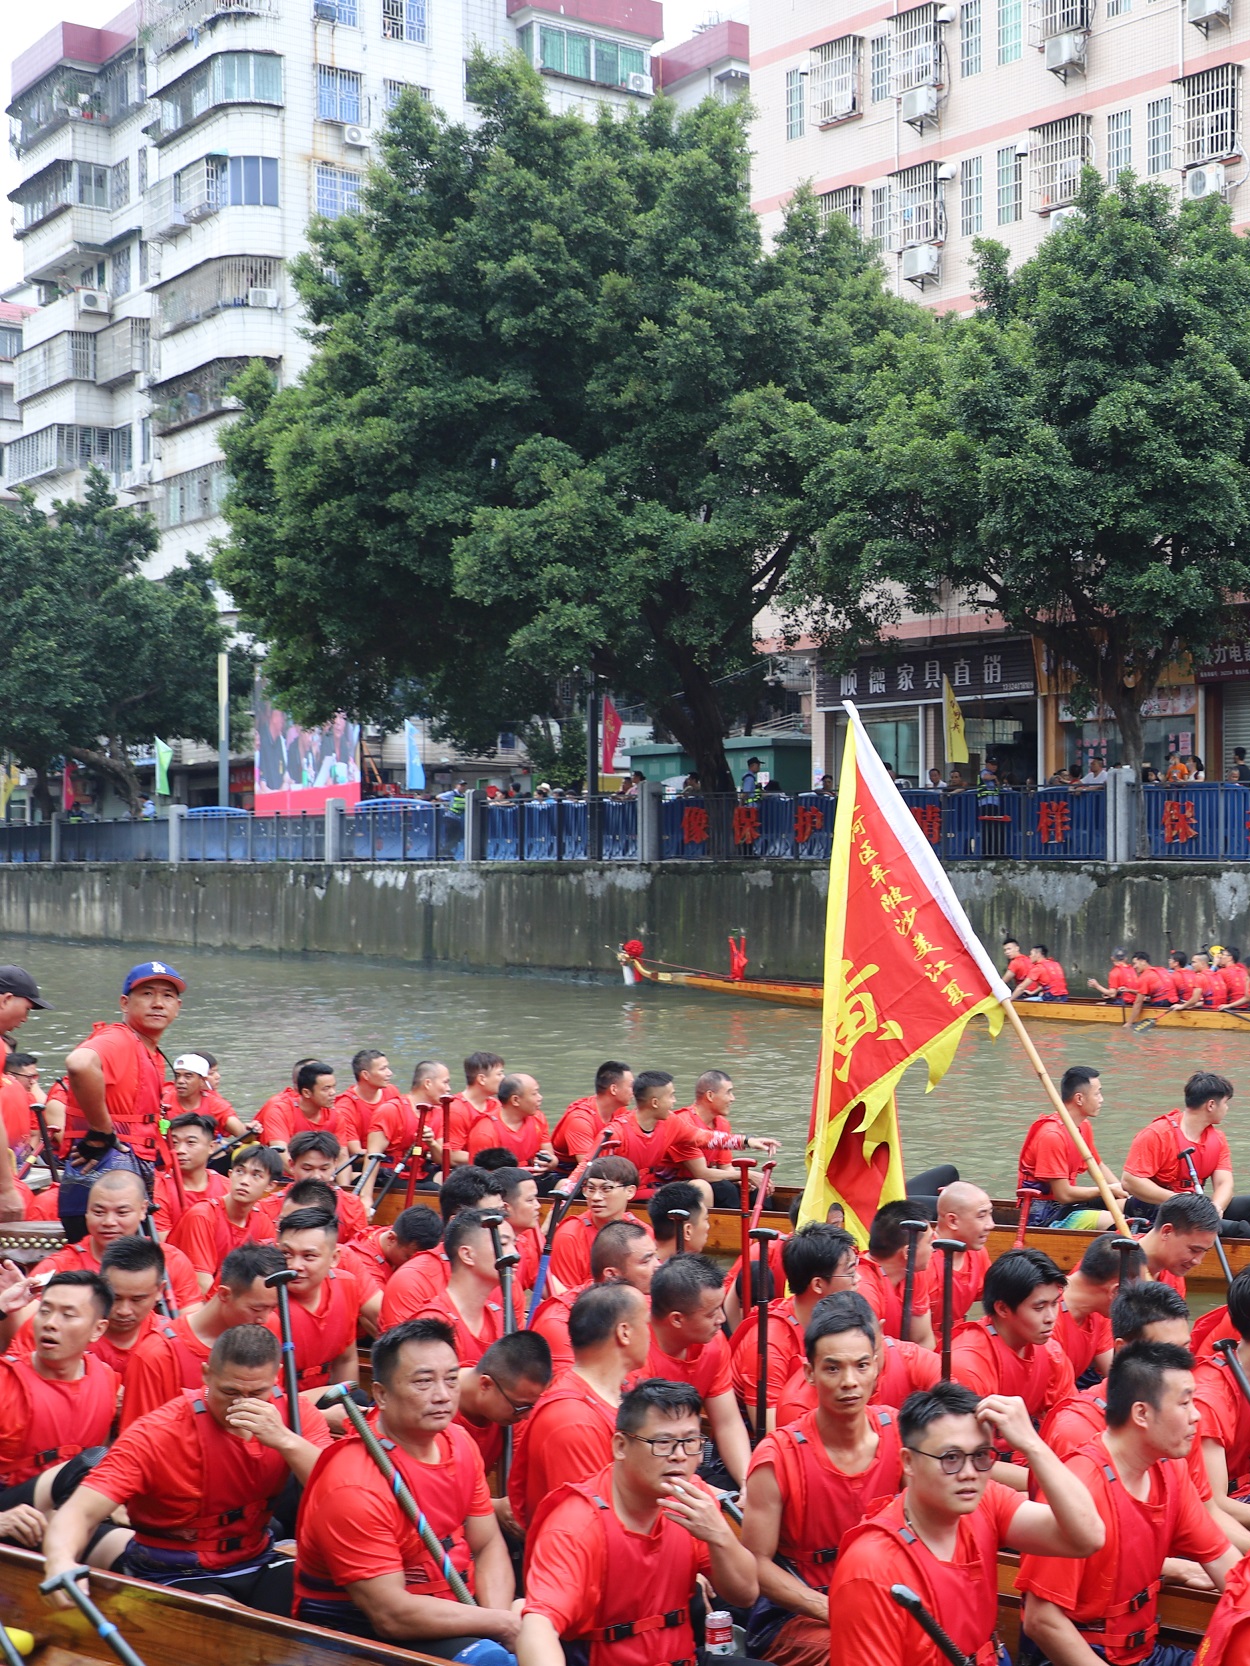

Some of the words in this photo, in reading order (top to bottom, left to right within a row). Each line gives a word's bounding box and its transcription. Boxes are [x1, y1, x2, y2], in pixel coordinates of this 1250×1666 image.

[840, 655, 1002, 697] 顺德家具直销
